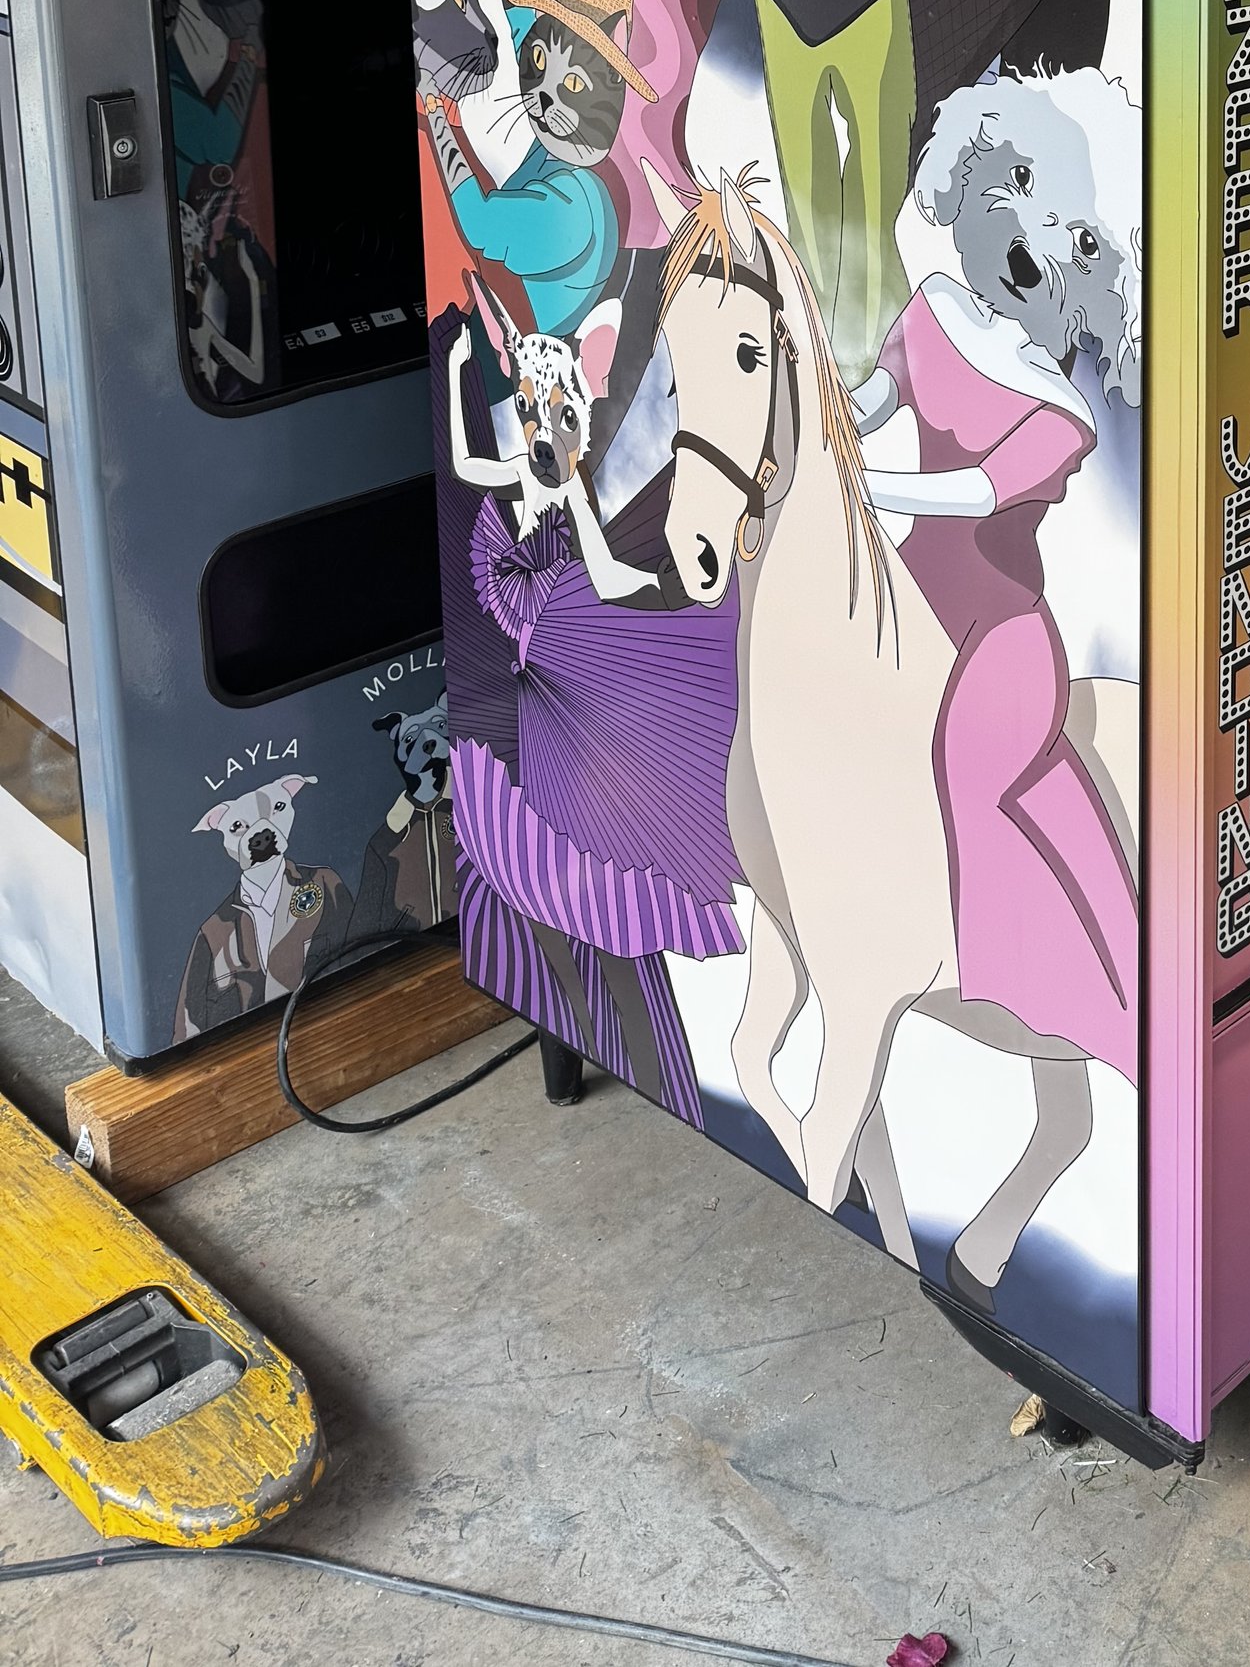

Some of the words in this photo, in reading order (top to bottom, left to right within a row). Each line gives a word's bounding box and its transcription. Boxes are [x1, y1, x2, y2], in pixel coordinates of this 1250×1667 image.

[351, 320, 371, 333] E5
[284, 336, 304, 350] E4
[204, 738, 299, 791] LAYLA
